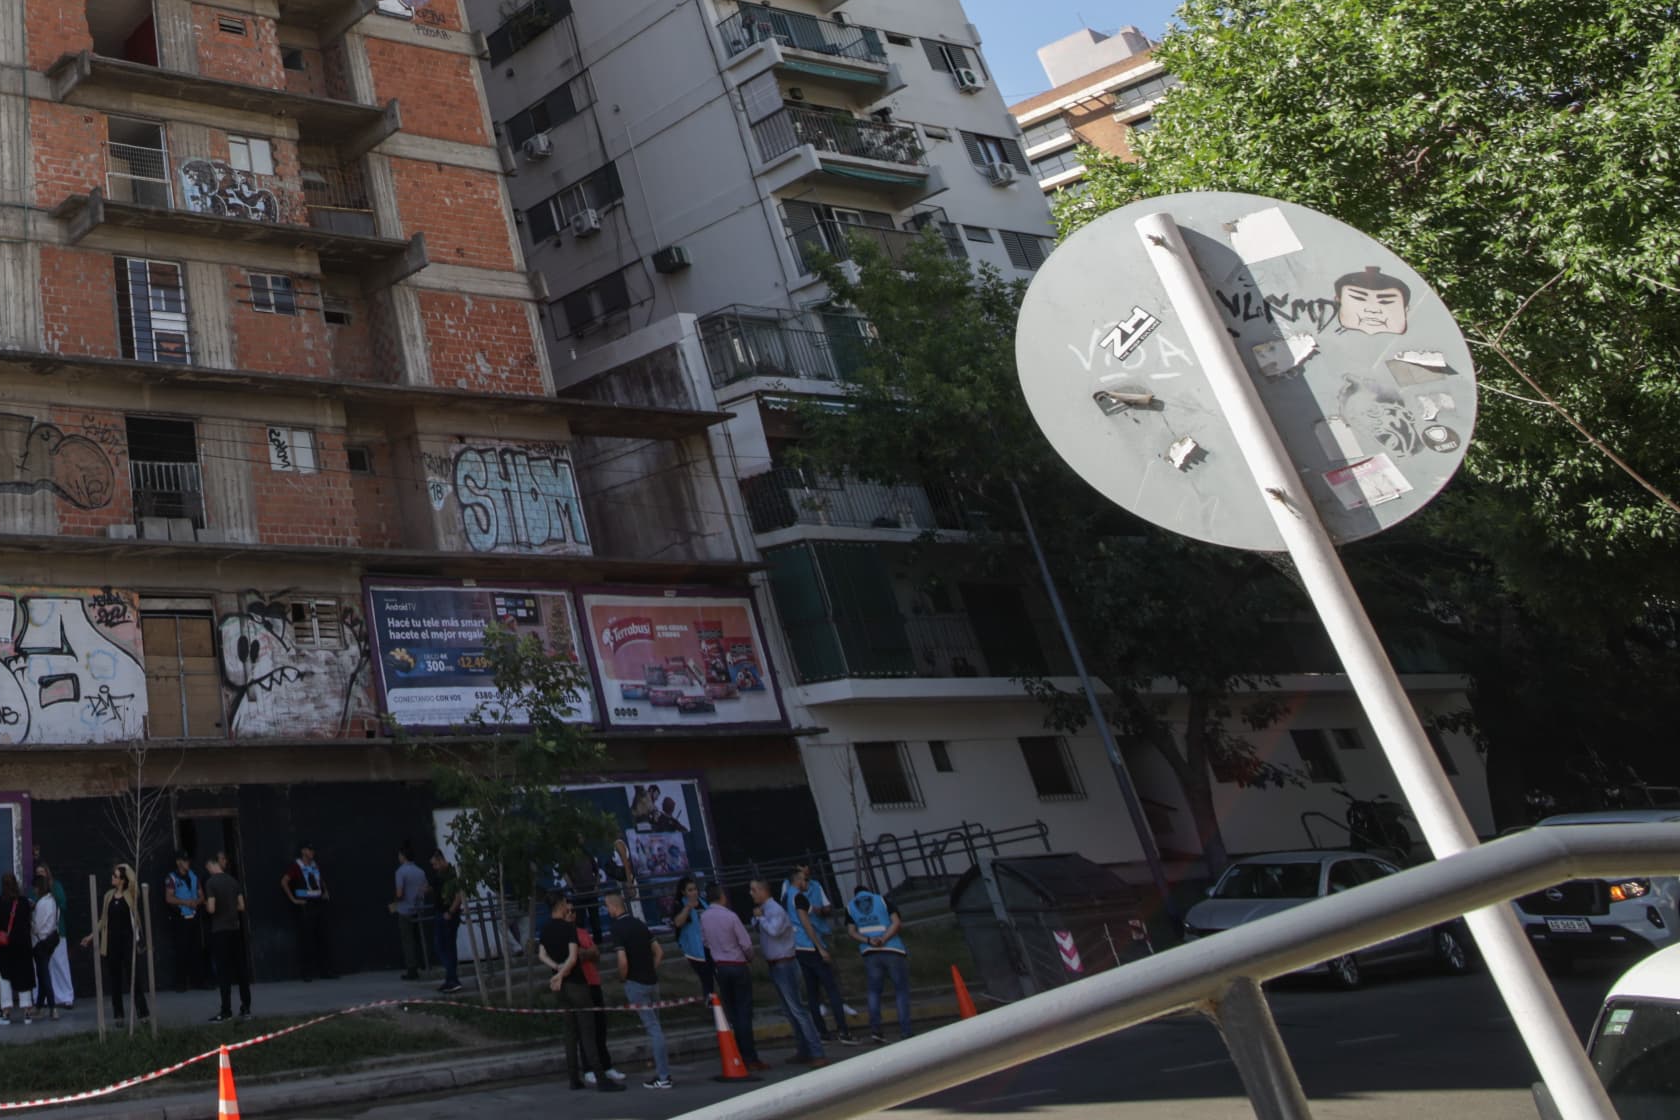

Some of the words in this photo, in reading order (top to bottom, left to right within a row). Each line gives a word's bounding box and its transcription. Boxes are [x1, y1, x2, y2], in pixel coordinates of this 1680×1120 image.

[384, 602, 408, 612] Android
[387, 617, 410, 628] Hacé
[411, 618, 422, 628] tu
[422, 617, 441, 628] tele
[442, 618, 459, 628] más
[389, 630, 420, 640] hacete
[421, 630, 429, 640] el
[430, 630, 457, 642] mejor
[425, 660, 445, 673] 300
